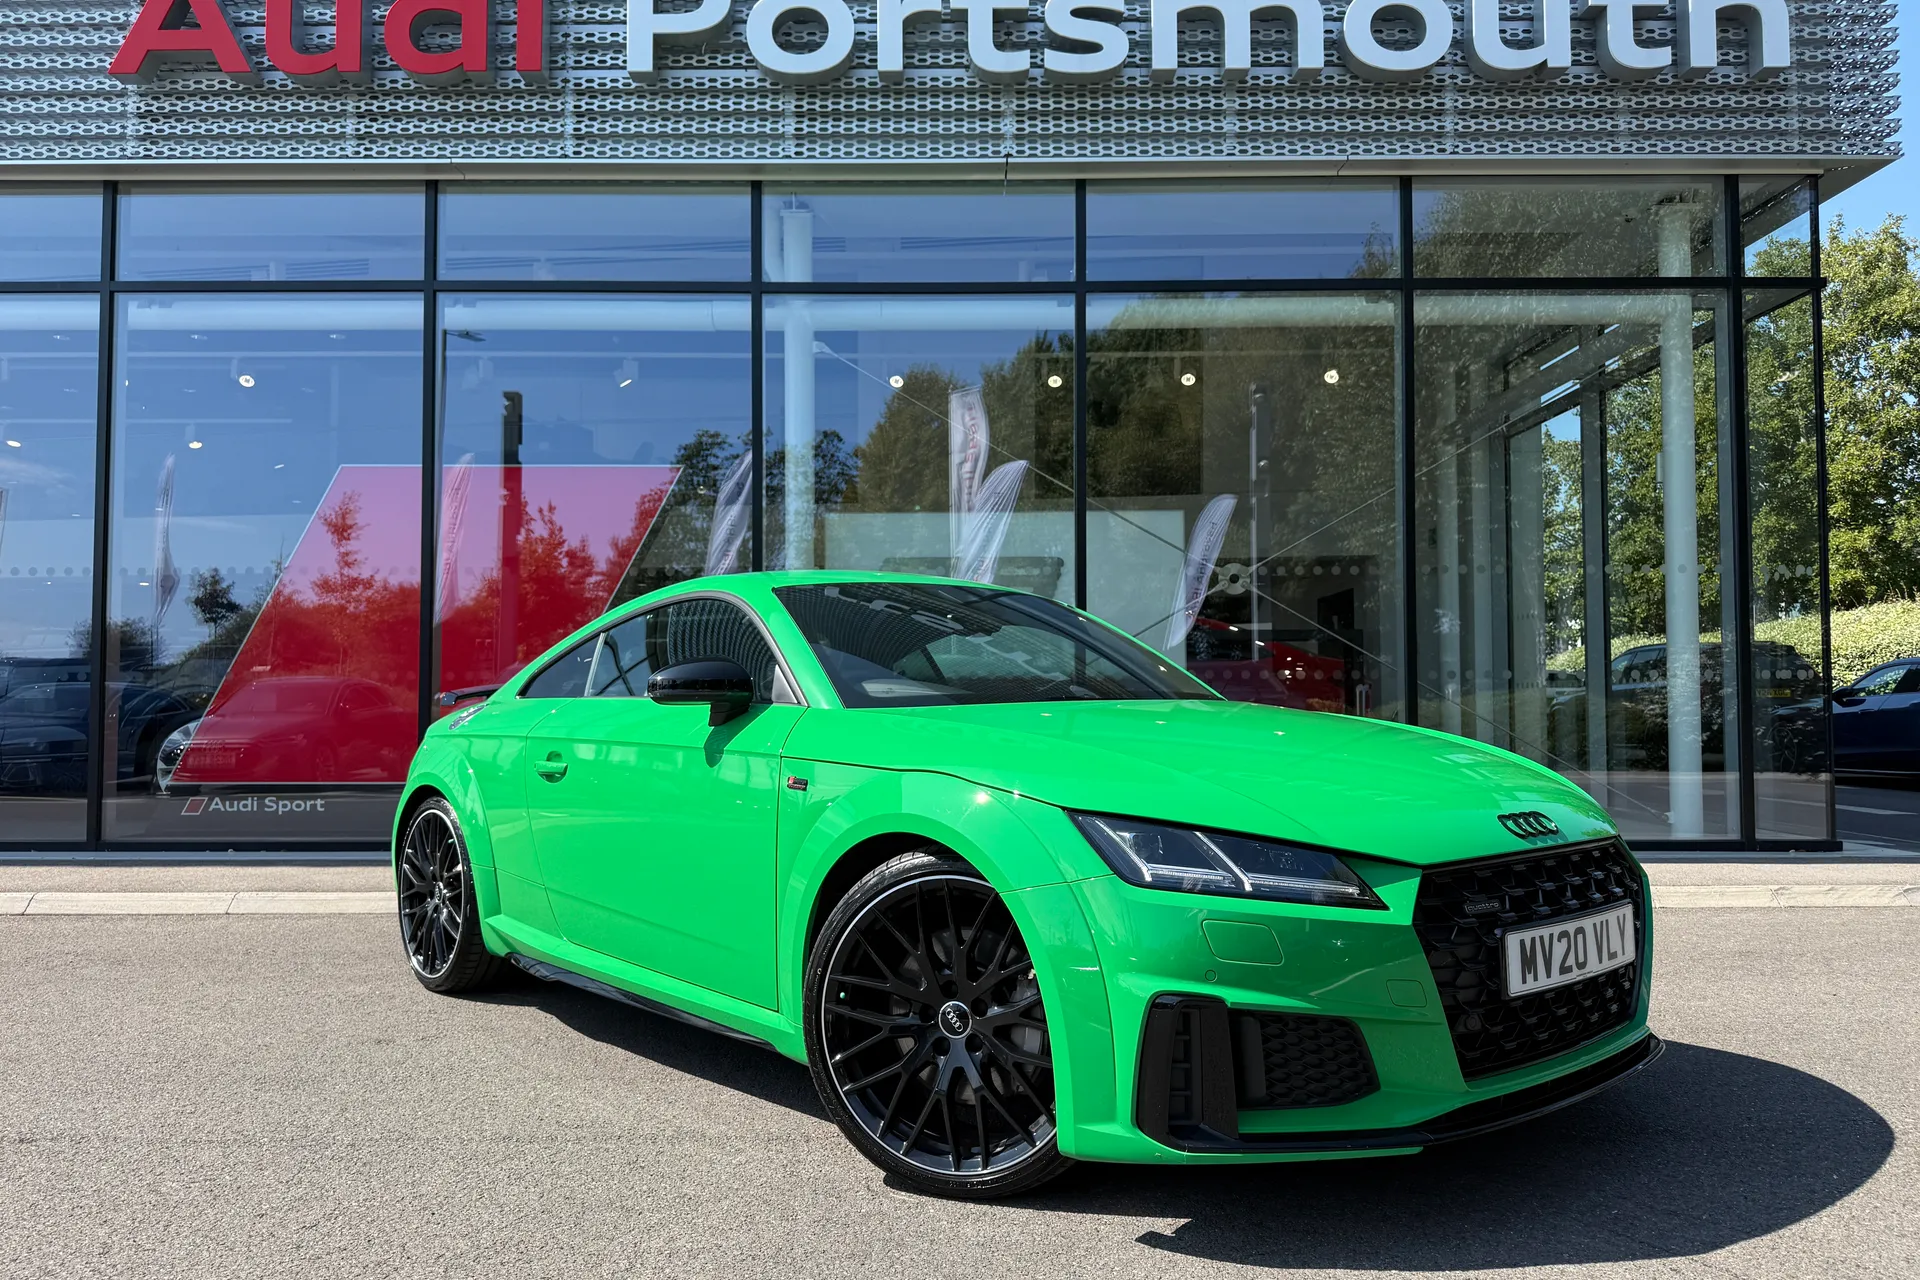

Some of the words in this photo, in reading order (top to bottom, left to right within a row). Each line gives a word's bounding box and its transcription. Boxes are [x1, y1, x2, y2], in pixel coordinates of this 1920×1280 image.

[107, 0, 546, 78] Audi
[626, 0, 1791, 78] Portsmouth
[208, 796, 258, 812] Audi
[264, 796, 326, 815] Sport
[1519, 925, 1588, 985] MV20
[1592, 913, 1627, 965] VLY
